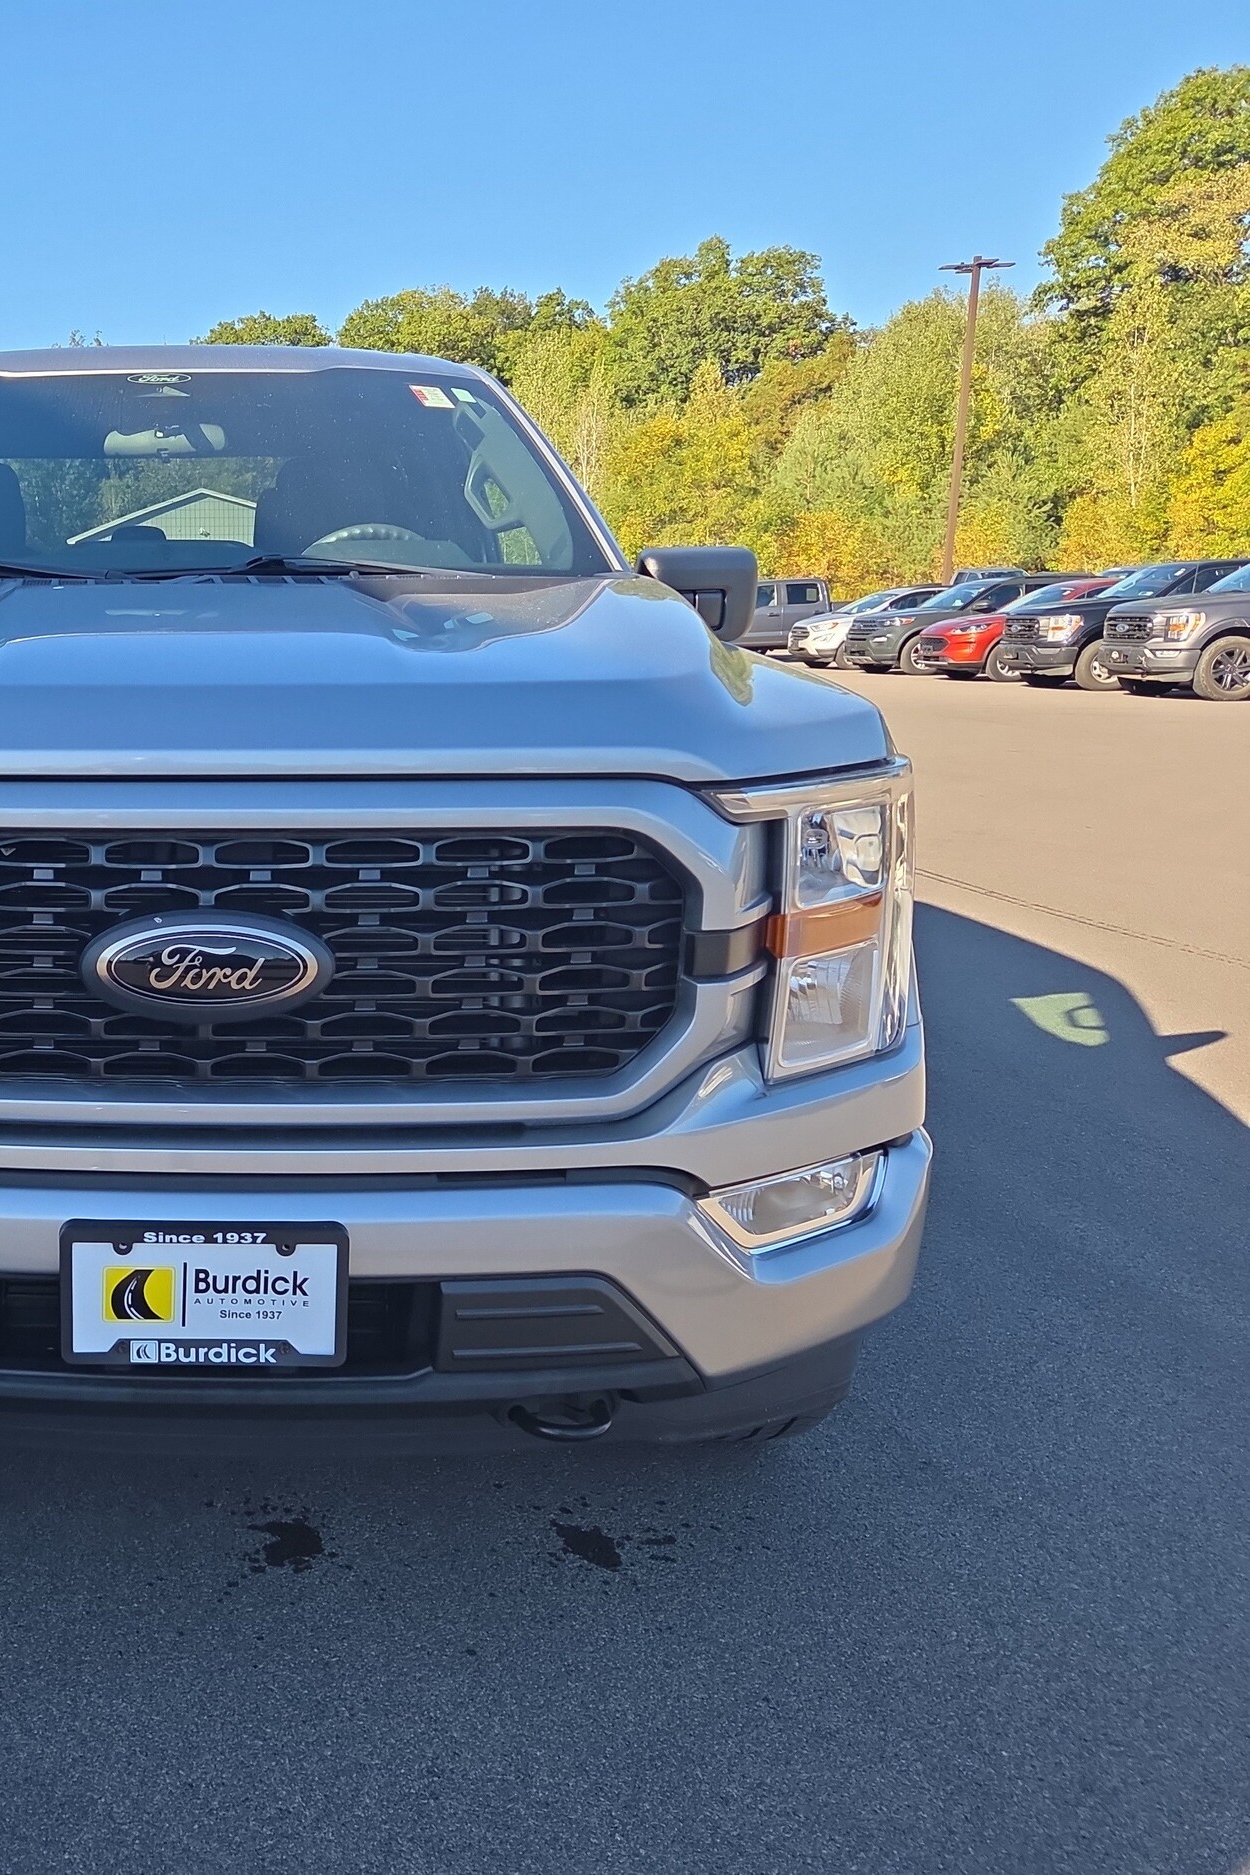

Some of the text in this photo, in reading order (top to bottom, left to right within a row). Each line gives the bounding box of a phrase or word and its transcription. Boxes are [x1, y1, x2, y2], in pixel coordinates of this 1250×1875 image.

[138, 374, 180, 382] Ford
[149, 943, 265, 990] Ford
[143, 1231, 268, 1244] Since 1937
[193, 1268, 310, 1297] Burdick
[193, 1298, 310, 1307] AUTOMOTIVE
[219, 1309, 283, 1320] Since 1937
[160, 1342, 277, 1364] Burdick
